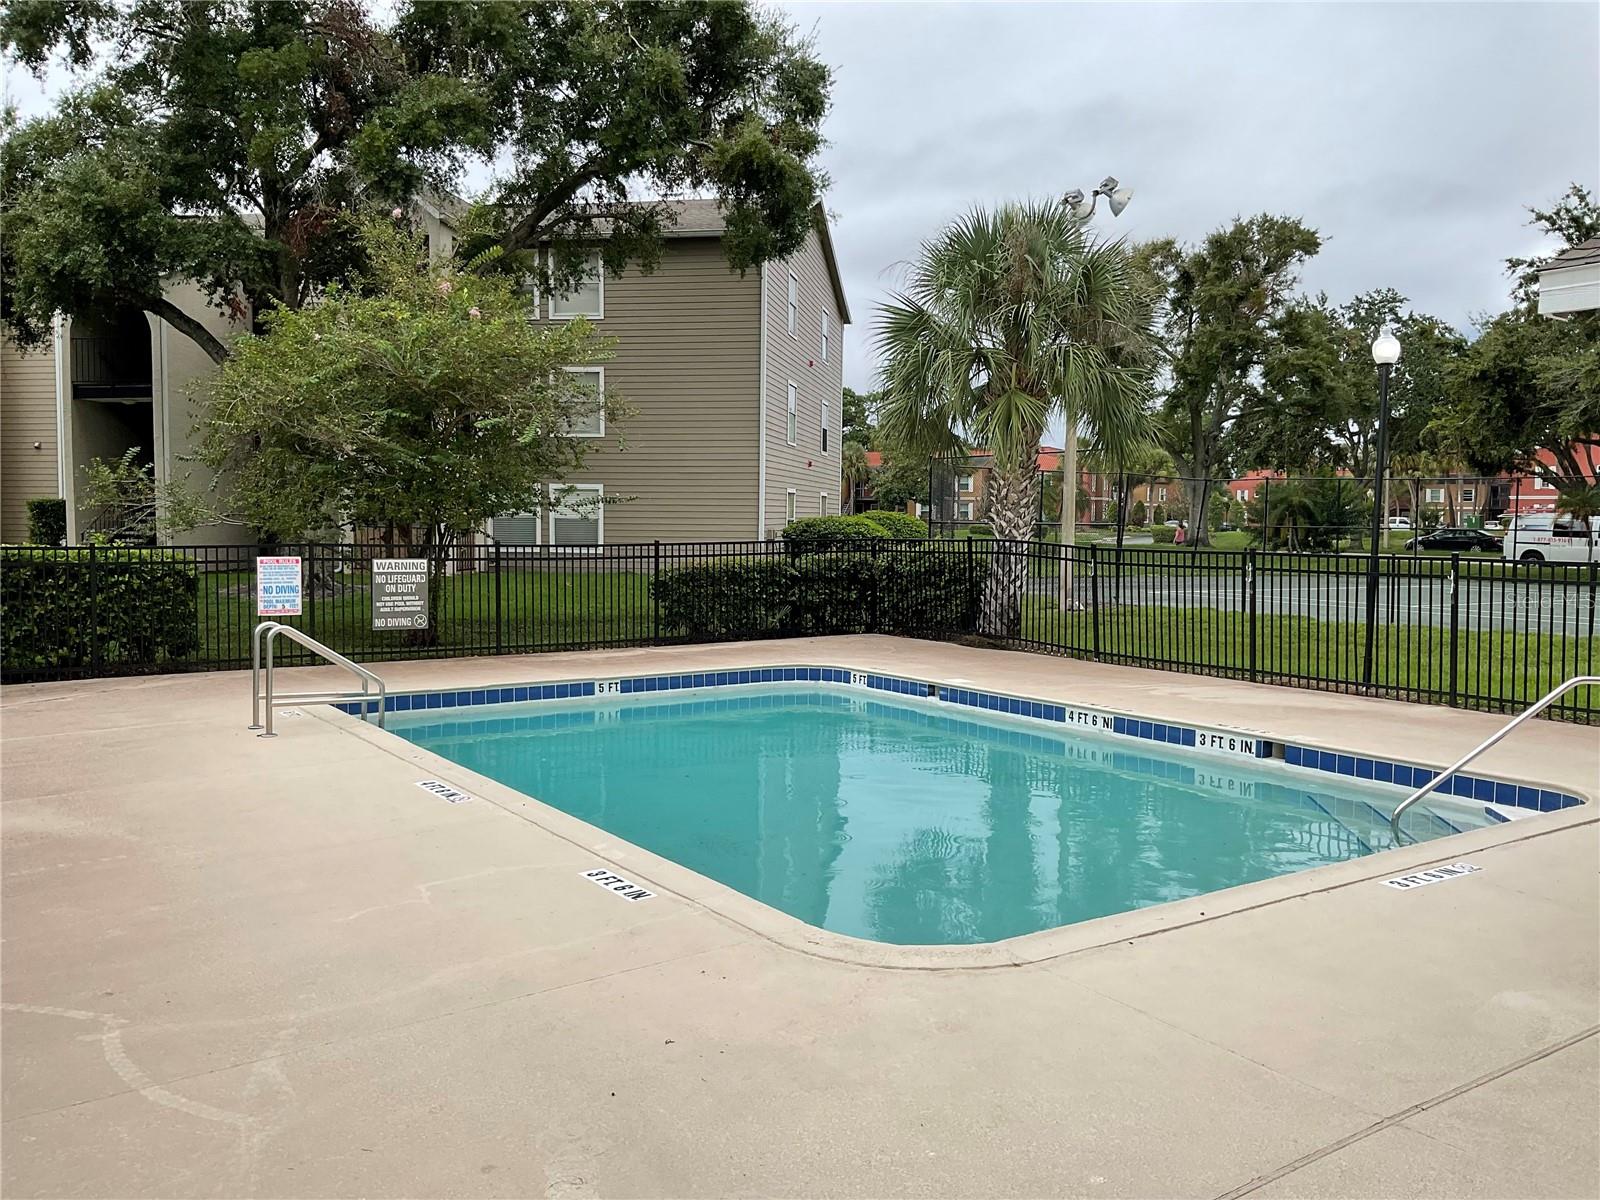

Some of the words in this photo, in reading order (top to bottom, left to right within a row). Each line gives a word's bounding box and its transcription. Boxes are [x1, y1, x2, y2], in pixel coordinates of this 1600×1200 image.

[375, 561, 426, 571] WARNING
[375, 574, 386, 584] NO
[387, 574, 426, 584] LIFEGUARD
[263, 584, 274, 595] NO
[275, 584, 300, 595] DIVING
[385, 584, 396, 593] ON
[397, 583, 417, 593] DUTY
[375, 618, 386, 627] NO
[387, 617, 412, 627] DIVING
[852, 673, 858, 684] 5
[598, 682, 605, 693] 5
[1068, 710, 1075, 723] 4
[1091, 714, 1098, 727] 6
[1199, 733, 1207, 746] 3
[1228, 738, 1236, 751] 6
[1240, 739, 1255, 755] IN.
[1388, 880, 1411, 888] 3
